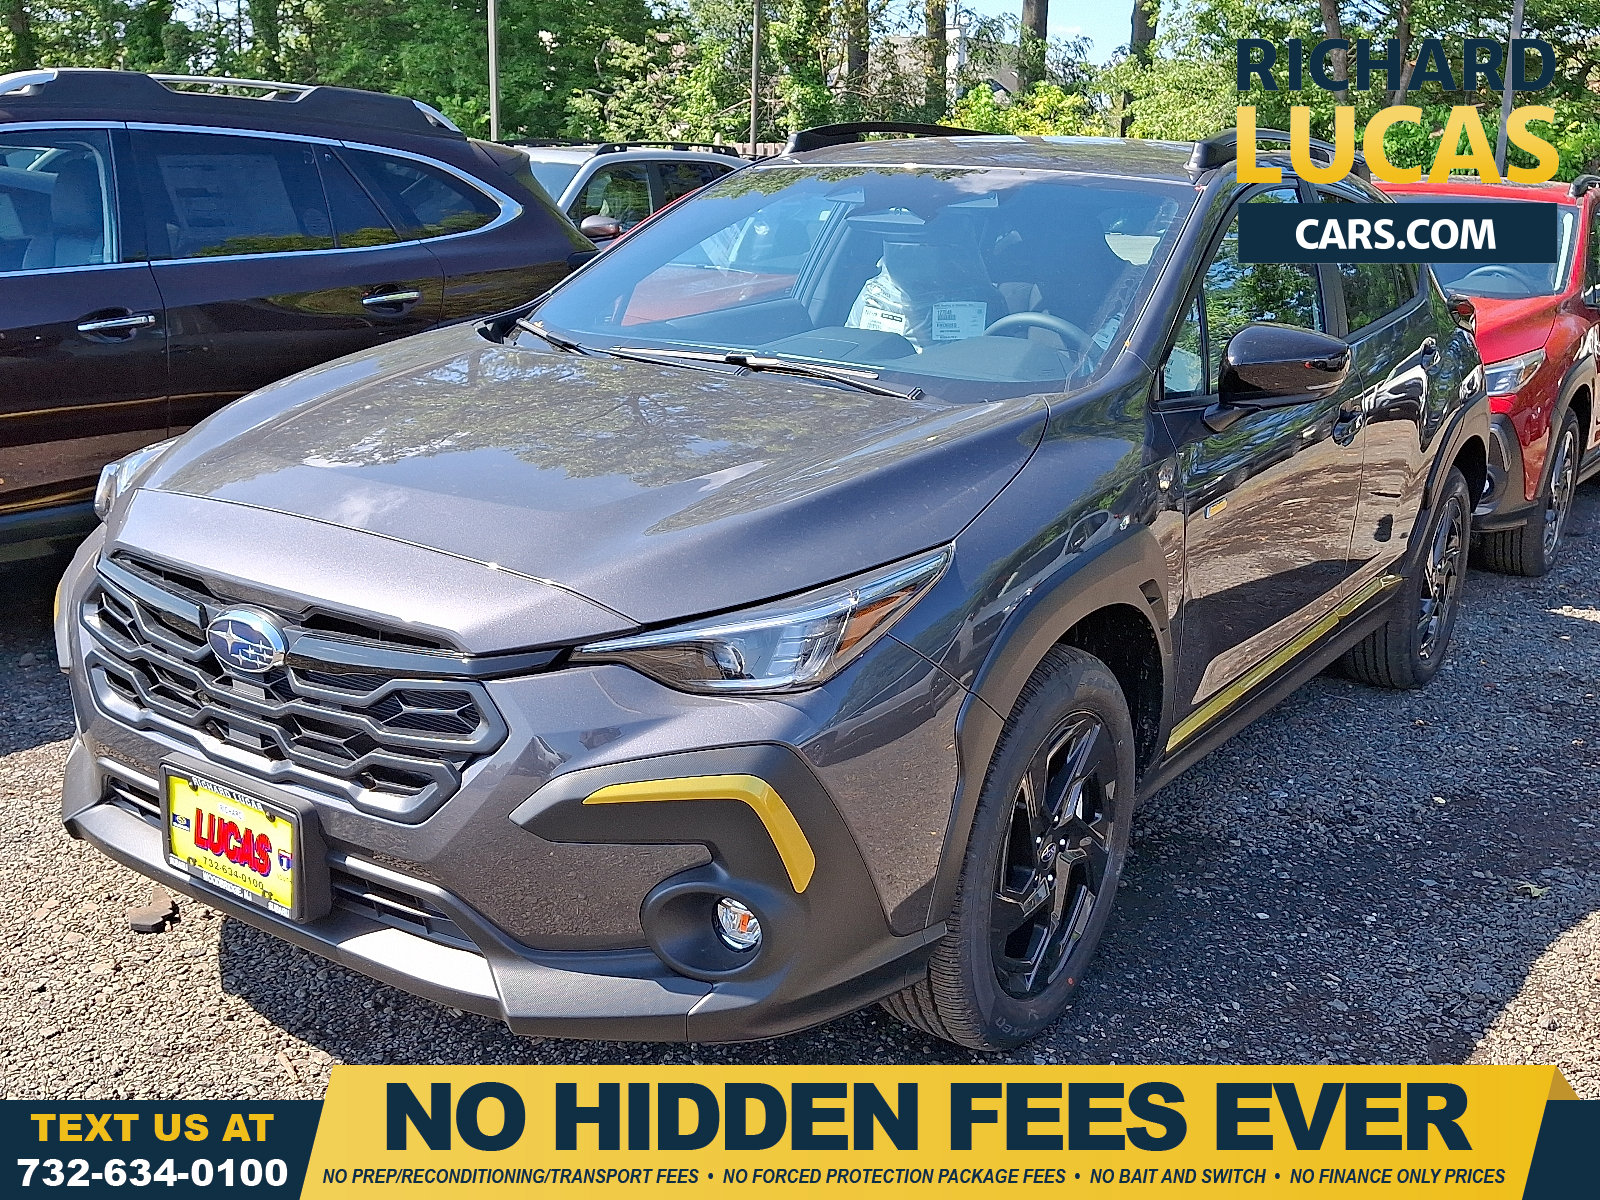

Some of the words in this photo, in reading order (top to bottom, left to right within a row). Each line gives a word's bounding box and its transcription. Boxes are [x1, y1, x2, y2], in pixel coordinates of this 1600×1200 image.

[192, 776, 231, 798] RICHARD
[194, 807, 272, 878] LUCAS
[203, 856, 264, 890] 732-634-0100
